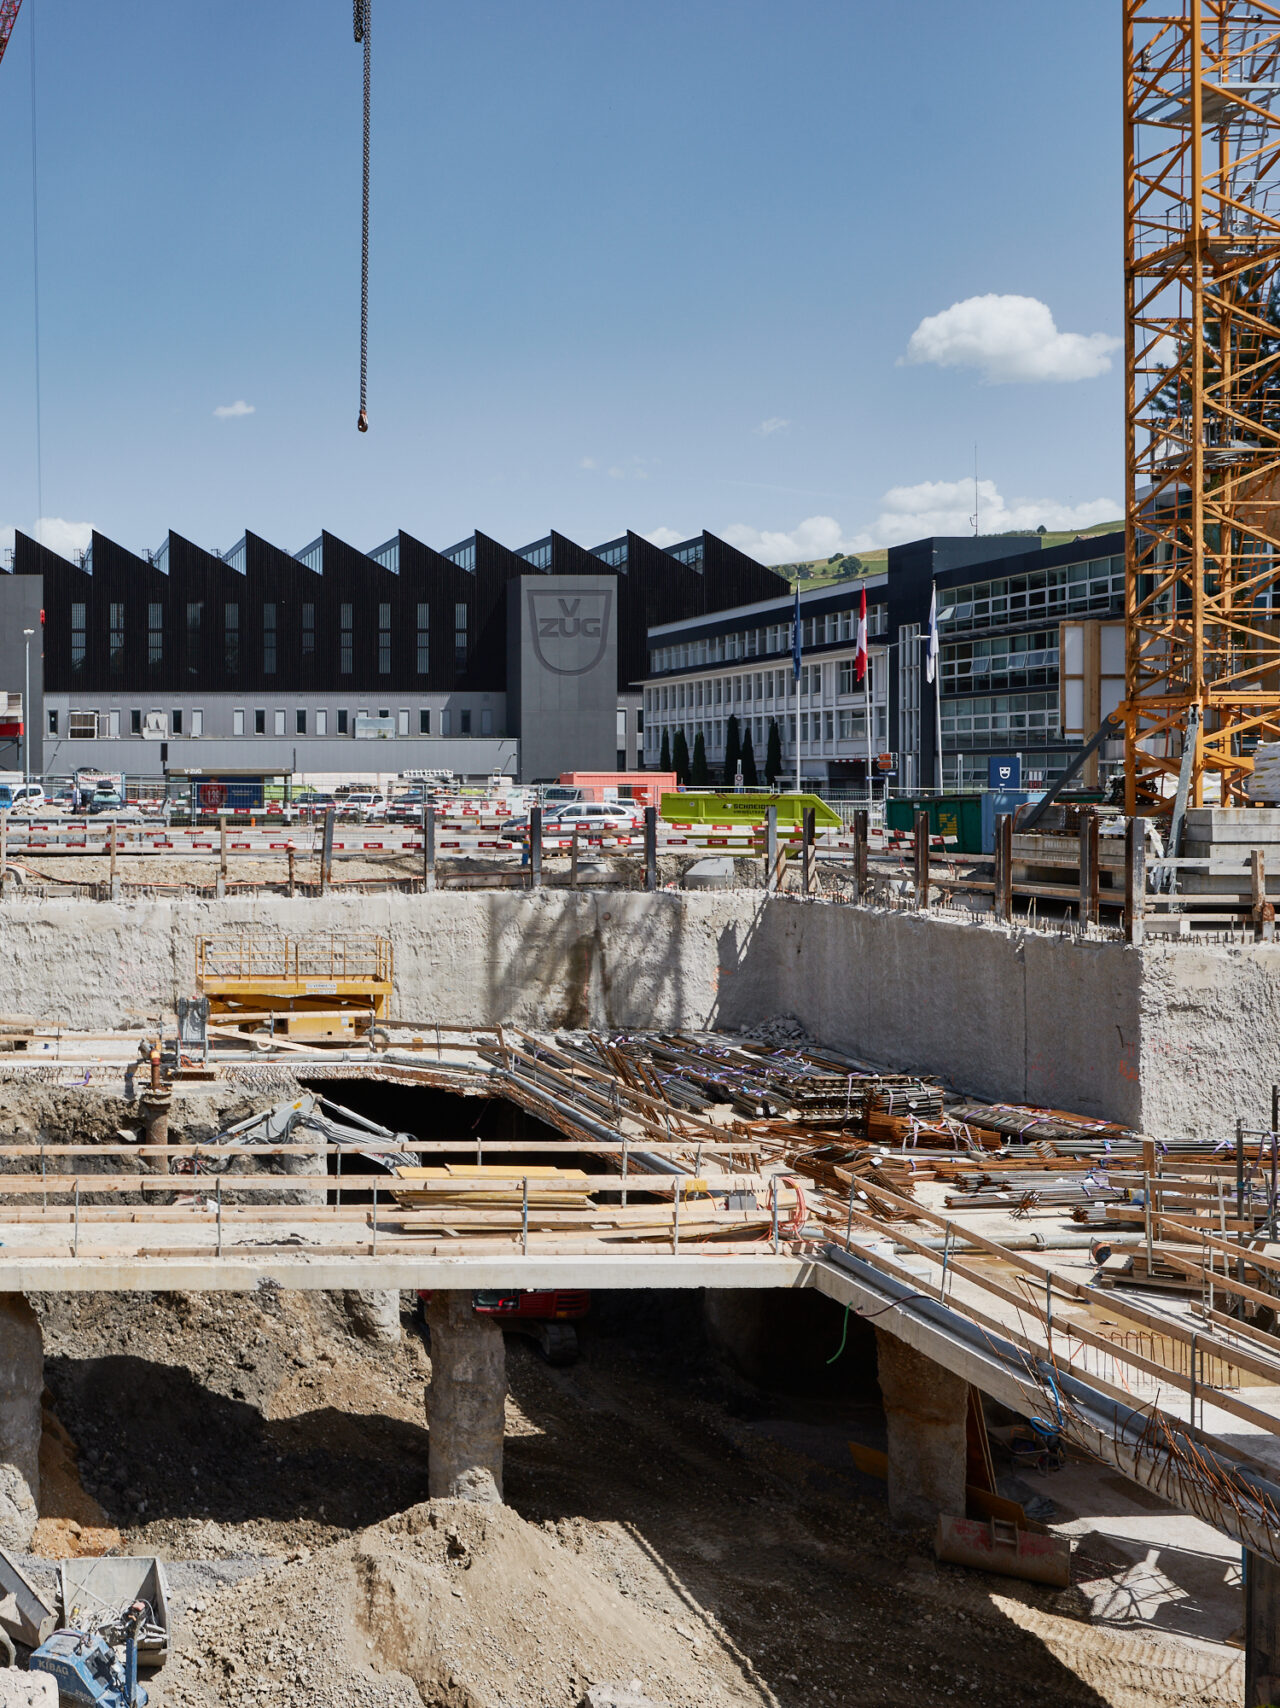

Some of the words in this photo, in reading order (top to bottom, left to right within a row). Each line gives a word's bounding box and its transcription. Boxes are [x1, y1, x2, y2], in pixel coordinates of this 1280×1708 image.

[557, 598, 582, 618] V
[539, 617, 601, 638] ZUG
[38, 1659, 69, 1676] KIBAG
